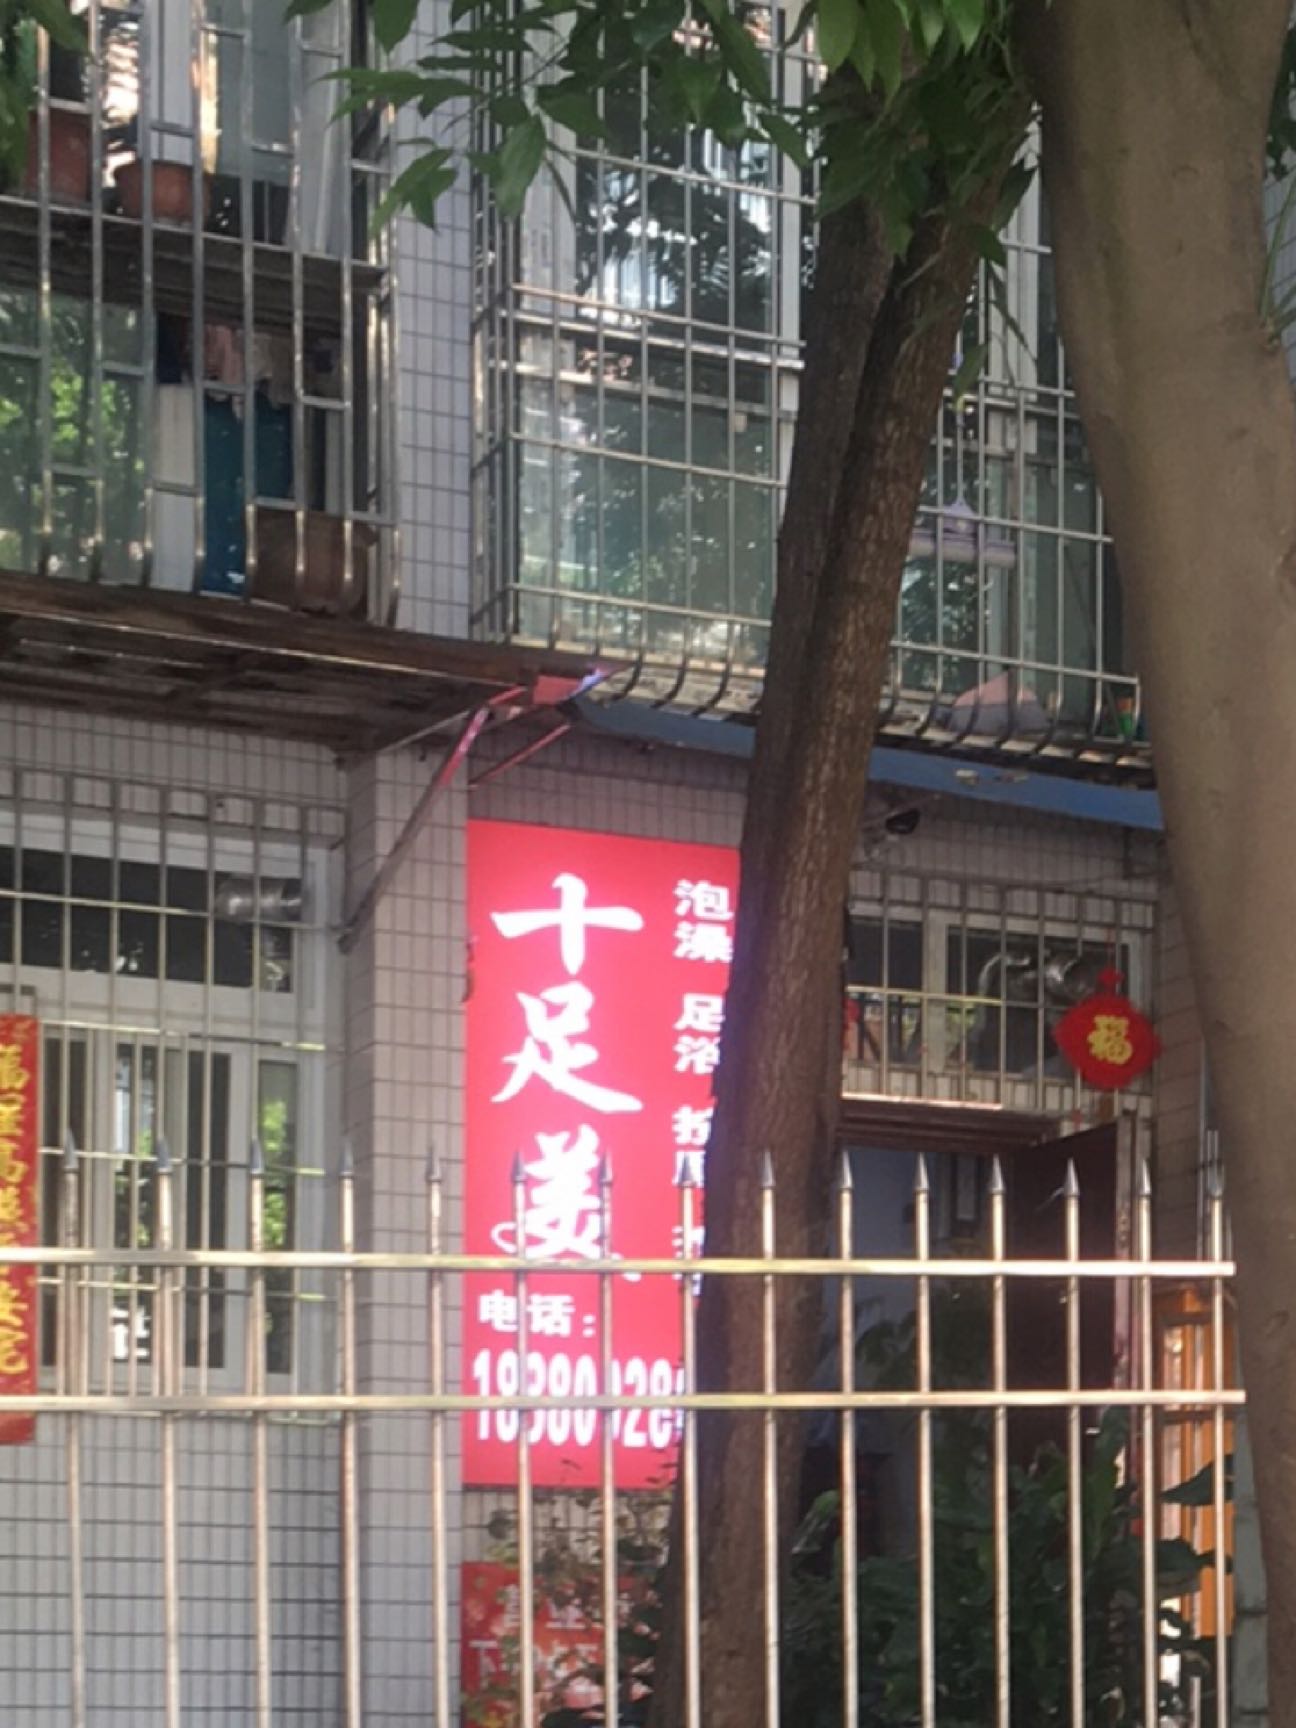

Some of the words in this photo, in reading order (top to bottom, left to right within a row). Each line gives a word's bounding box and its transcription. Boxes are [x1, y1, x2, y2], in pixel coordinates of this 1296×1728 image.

[673, 878, 733, 963] 泡澡
[490, 872, 644, 1281] 十足美
[1086, 1015, 1134, 1065] 福
